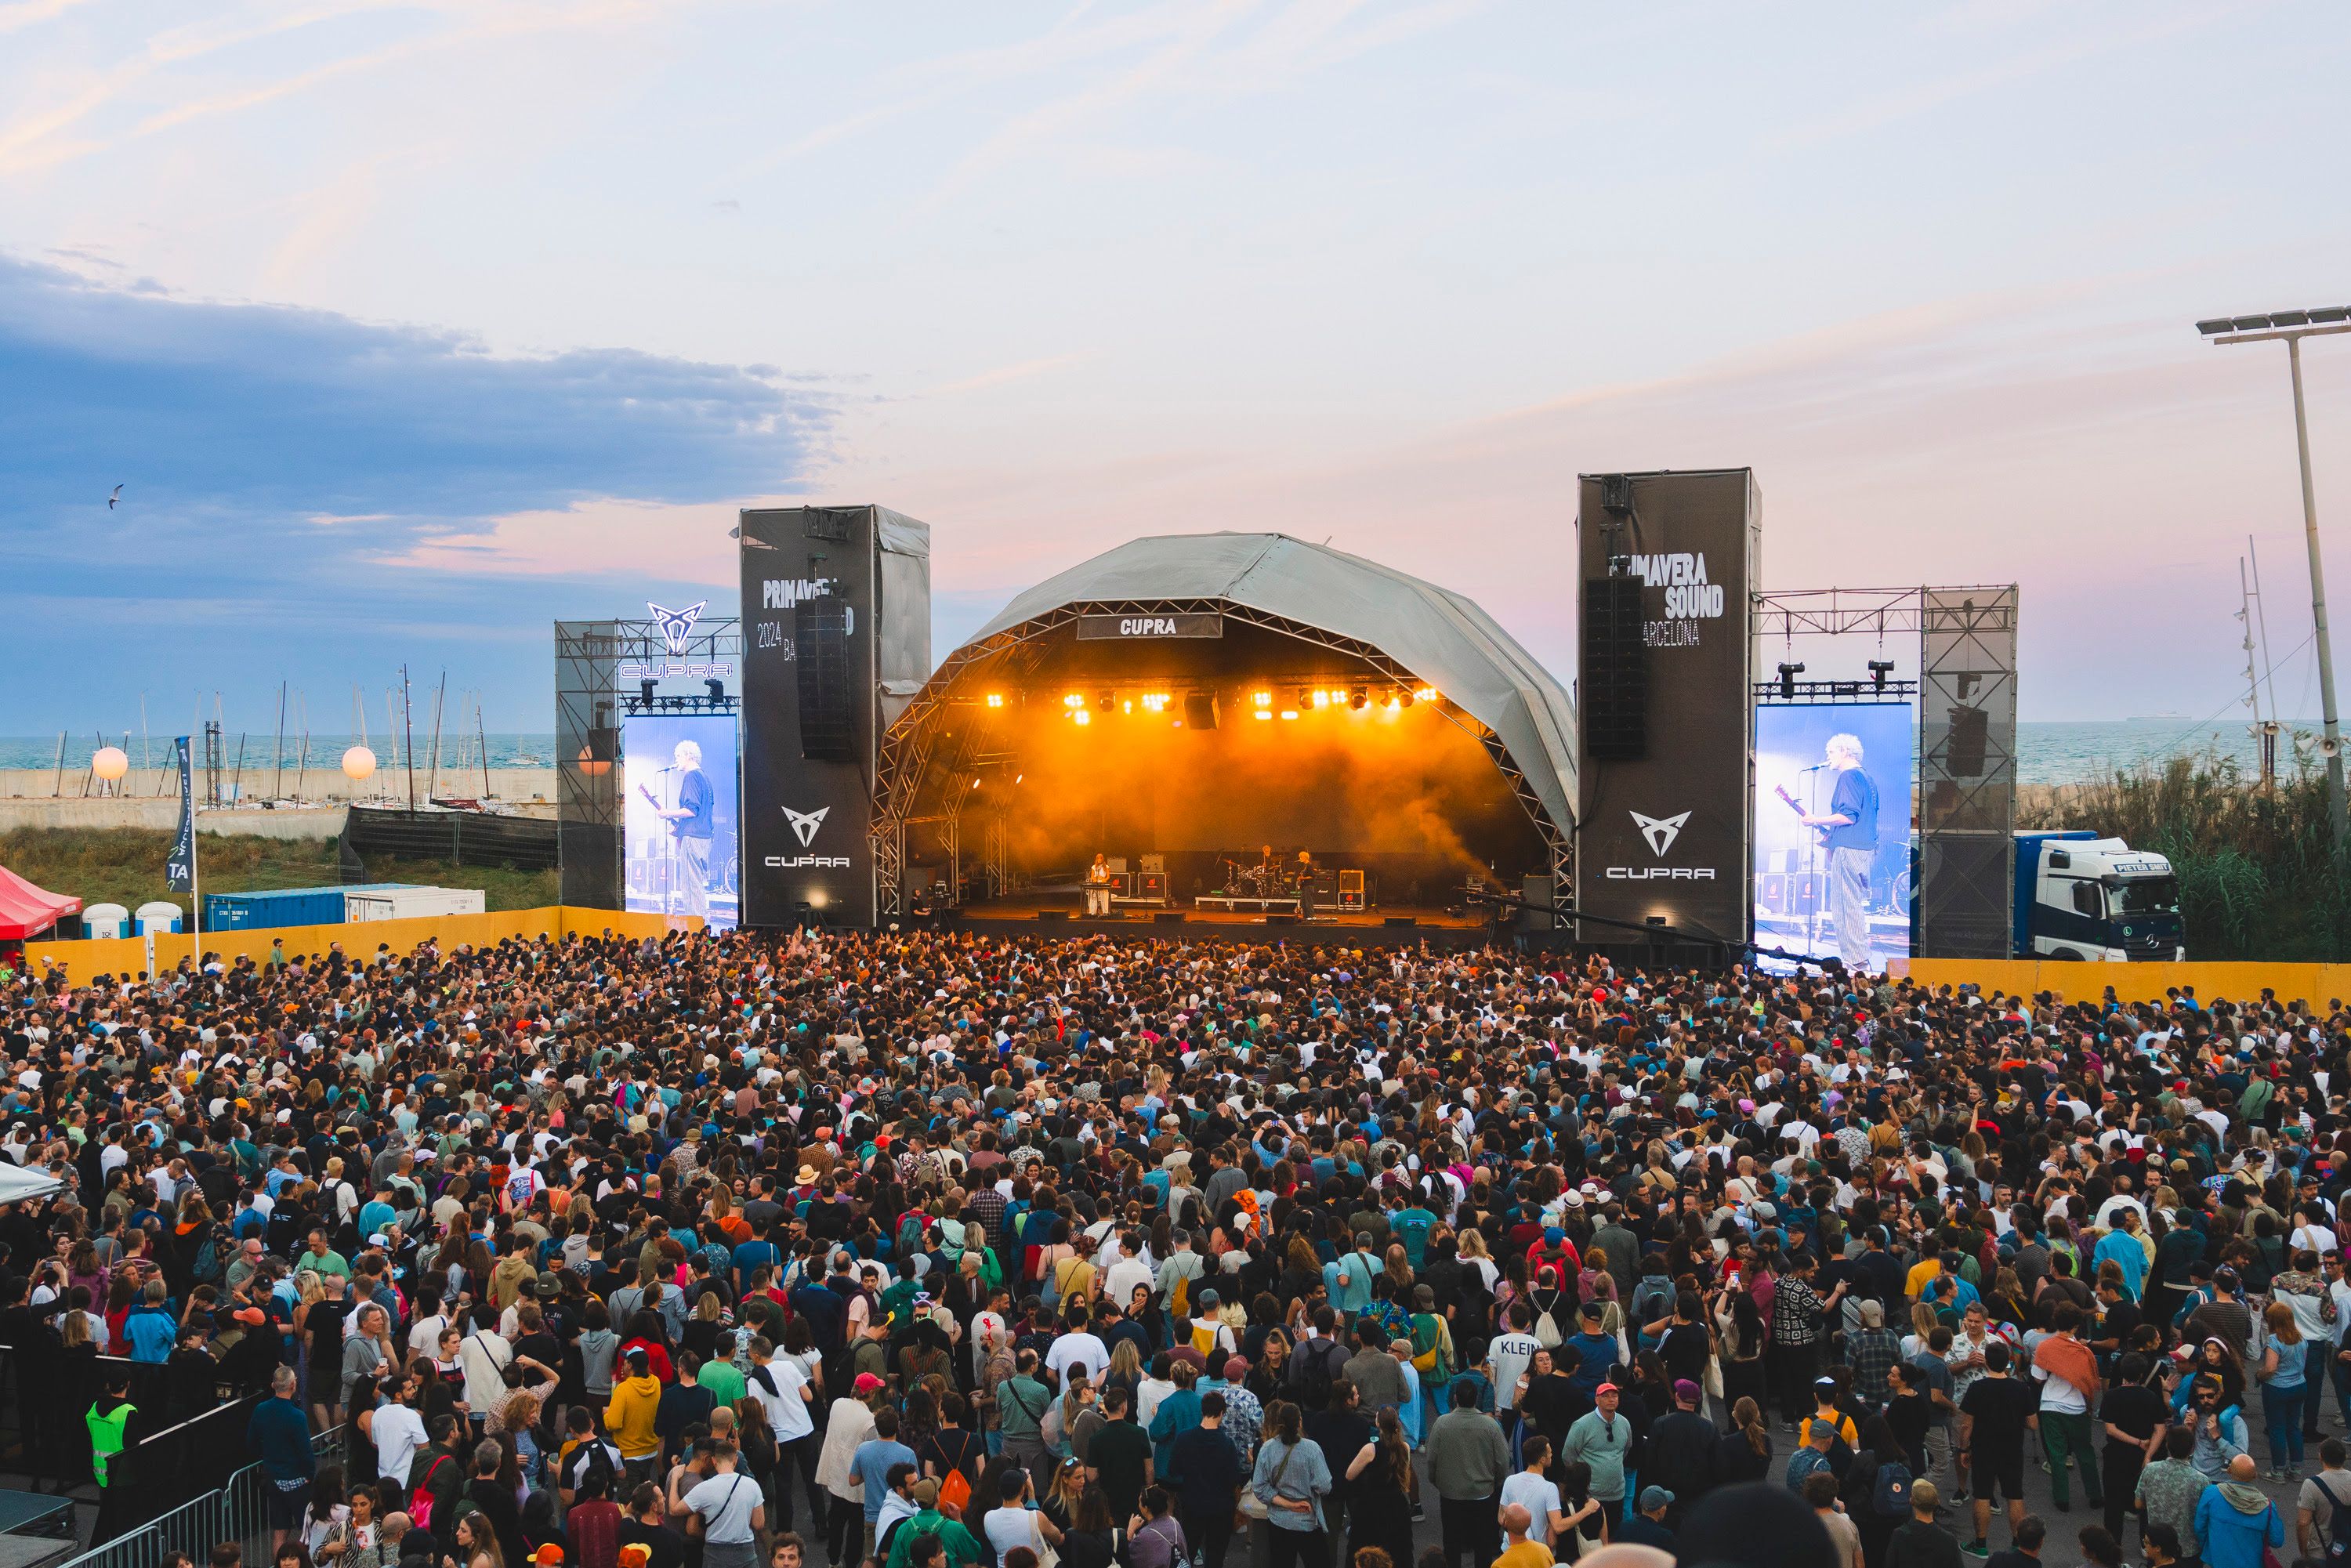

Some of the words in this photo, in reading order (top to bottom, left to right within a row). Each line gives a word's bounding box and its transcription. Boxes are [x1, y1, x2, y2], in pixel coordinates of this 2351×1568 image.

[1609, 552, 1708, 586] IMAVERA
[1665, 585, 1723, 619] SOUND
[757, 621, 781, 648] 2024
[1120, 618, 1176, 635] CUPRA
[1643, 620, 1699, 646] ARCELONA
[621, 663, 732, 679] CUPRA
[765, 856, 849, 867] CUPRA
[1607, 867, 1715, 879] CUPRA
[1501, 1341, 1540, 1356] KLEIN
